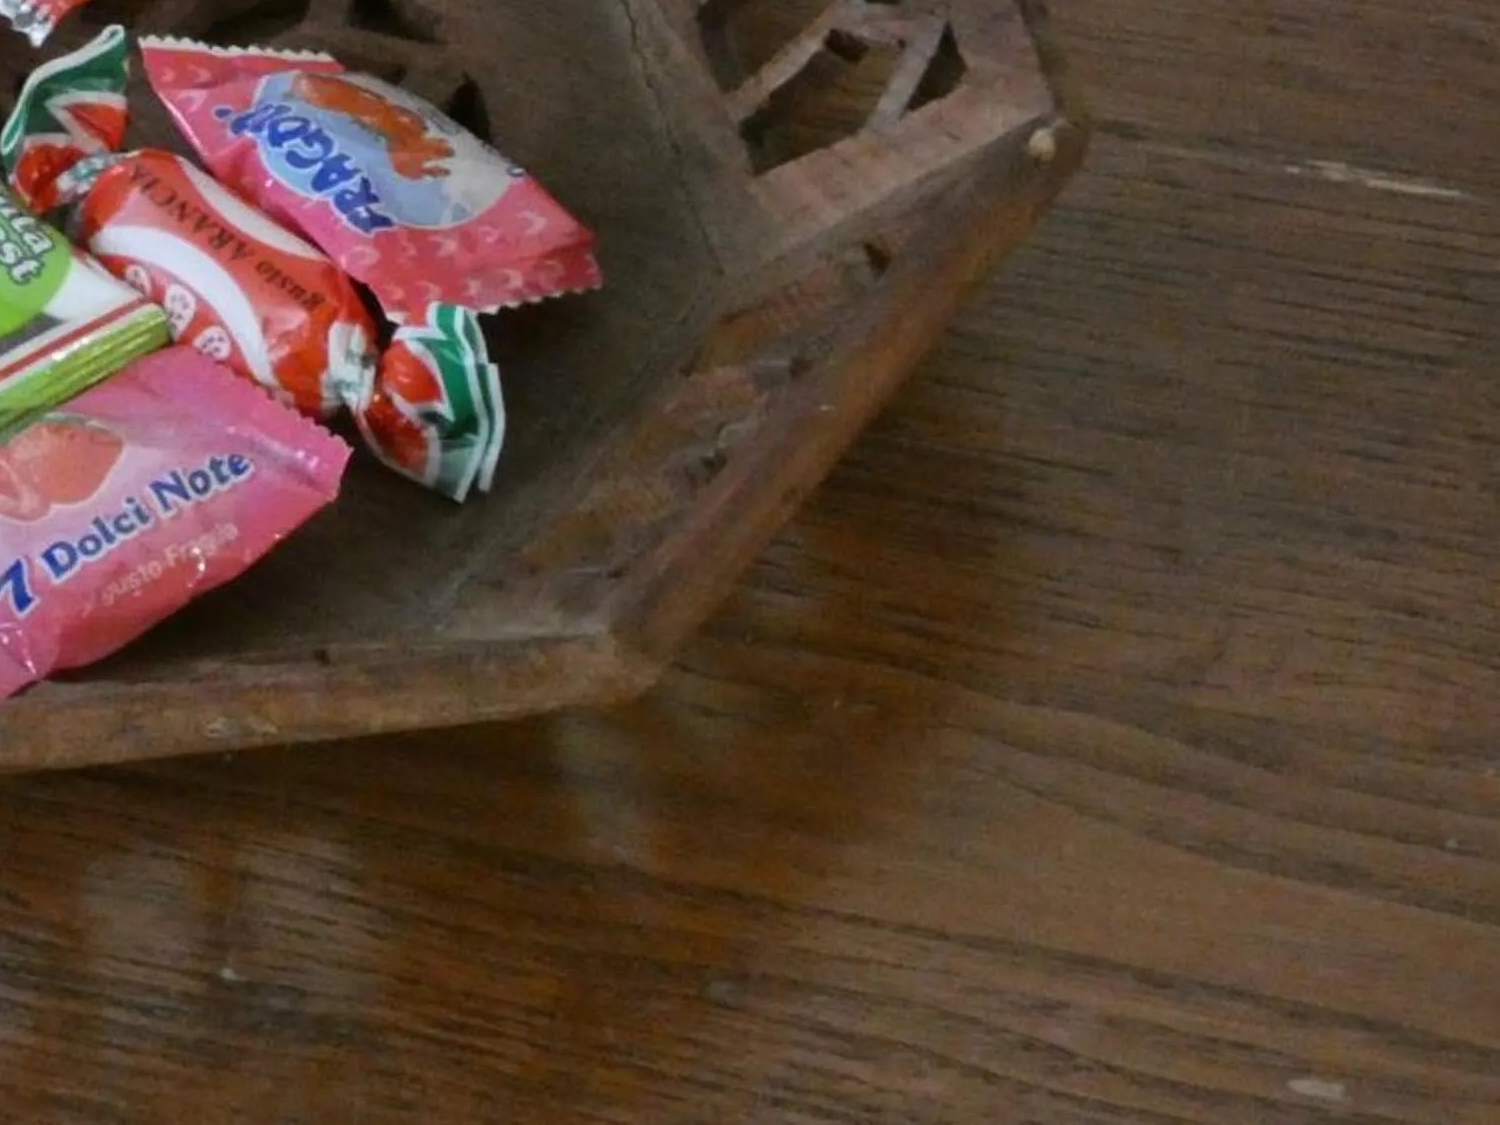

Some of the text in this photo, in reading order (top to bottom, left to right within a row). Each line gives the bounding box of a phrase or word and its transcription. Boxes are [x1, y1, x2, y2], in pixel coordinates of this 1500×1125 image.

[255, 260, 326, 312] gusto
[41, 498, 150, 581] Dolci
[149, 450, 253, 515] Note
